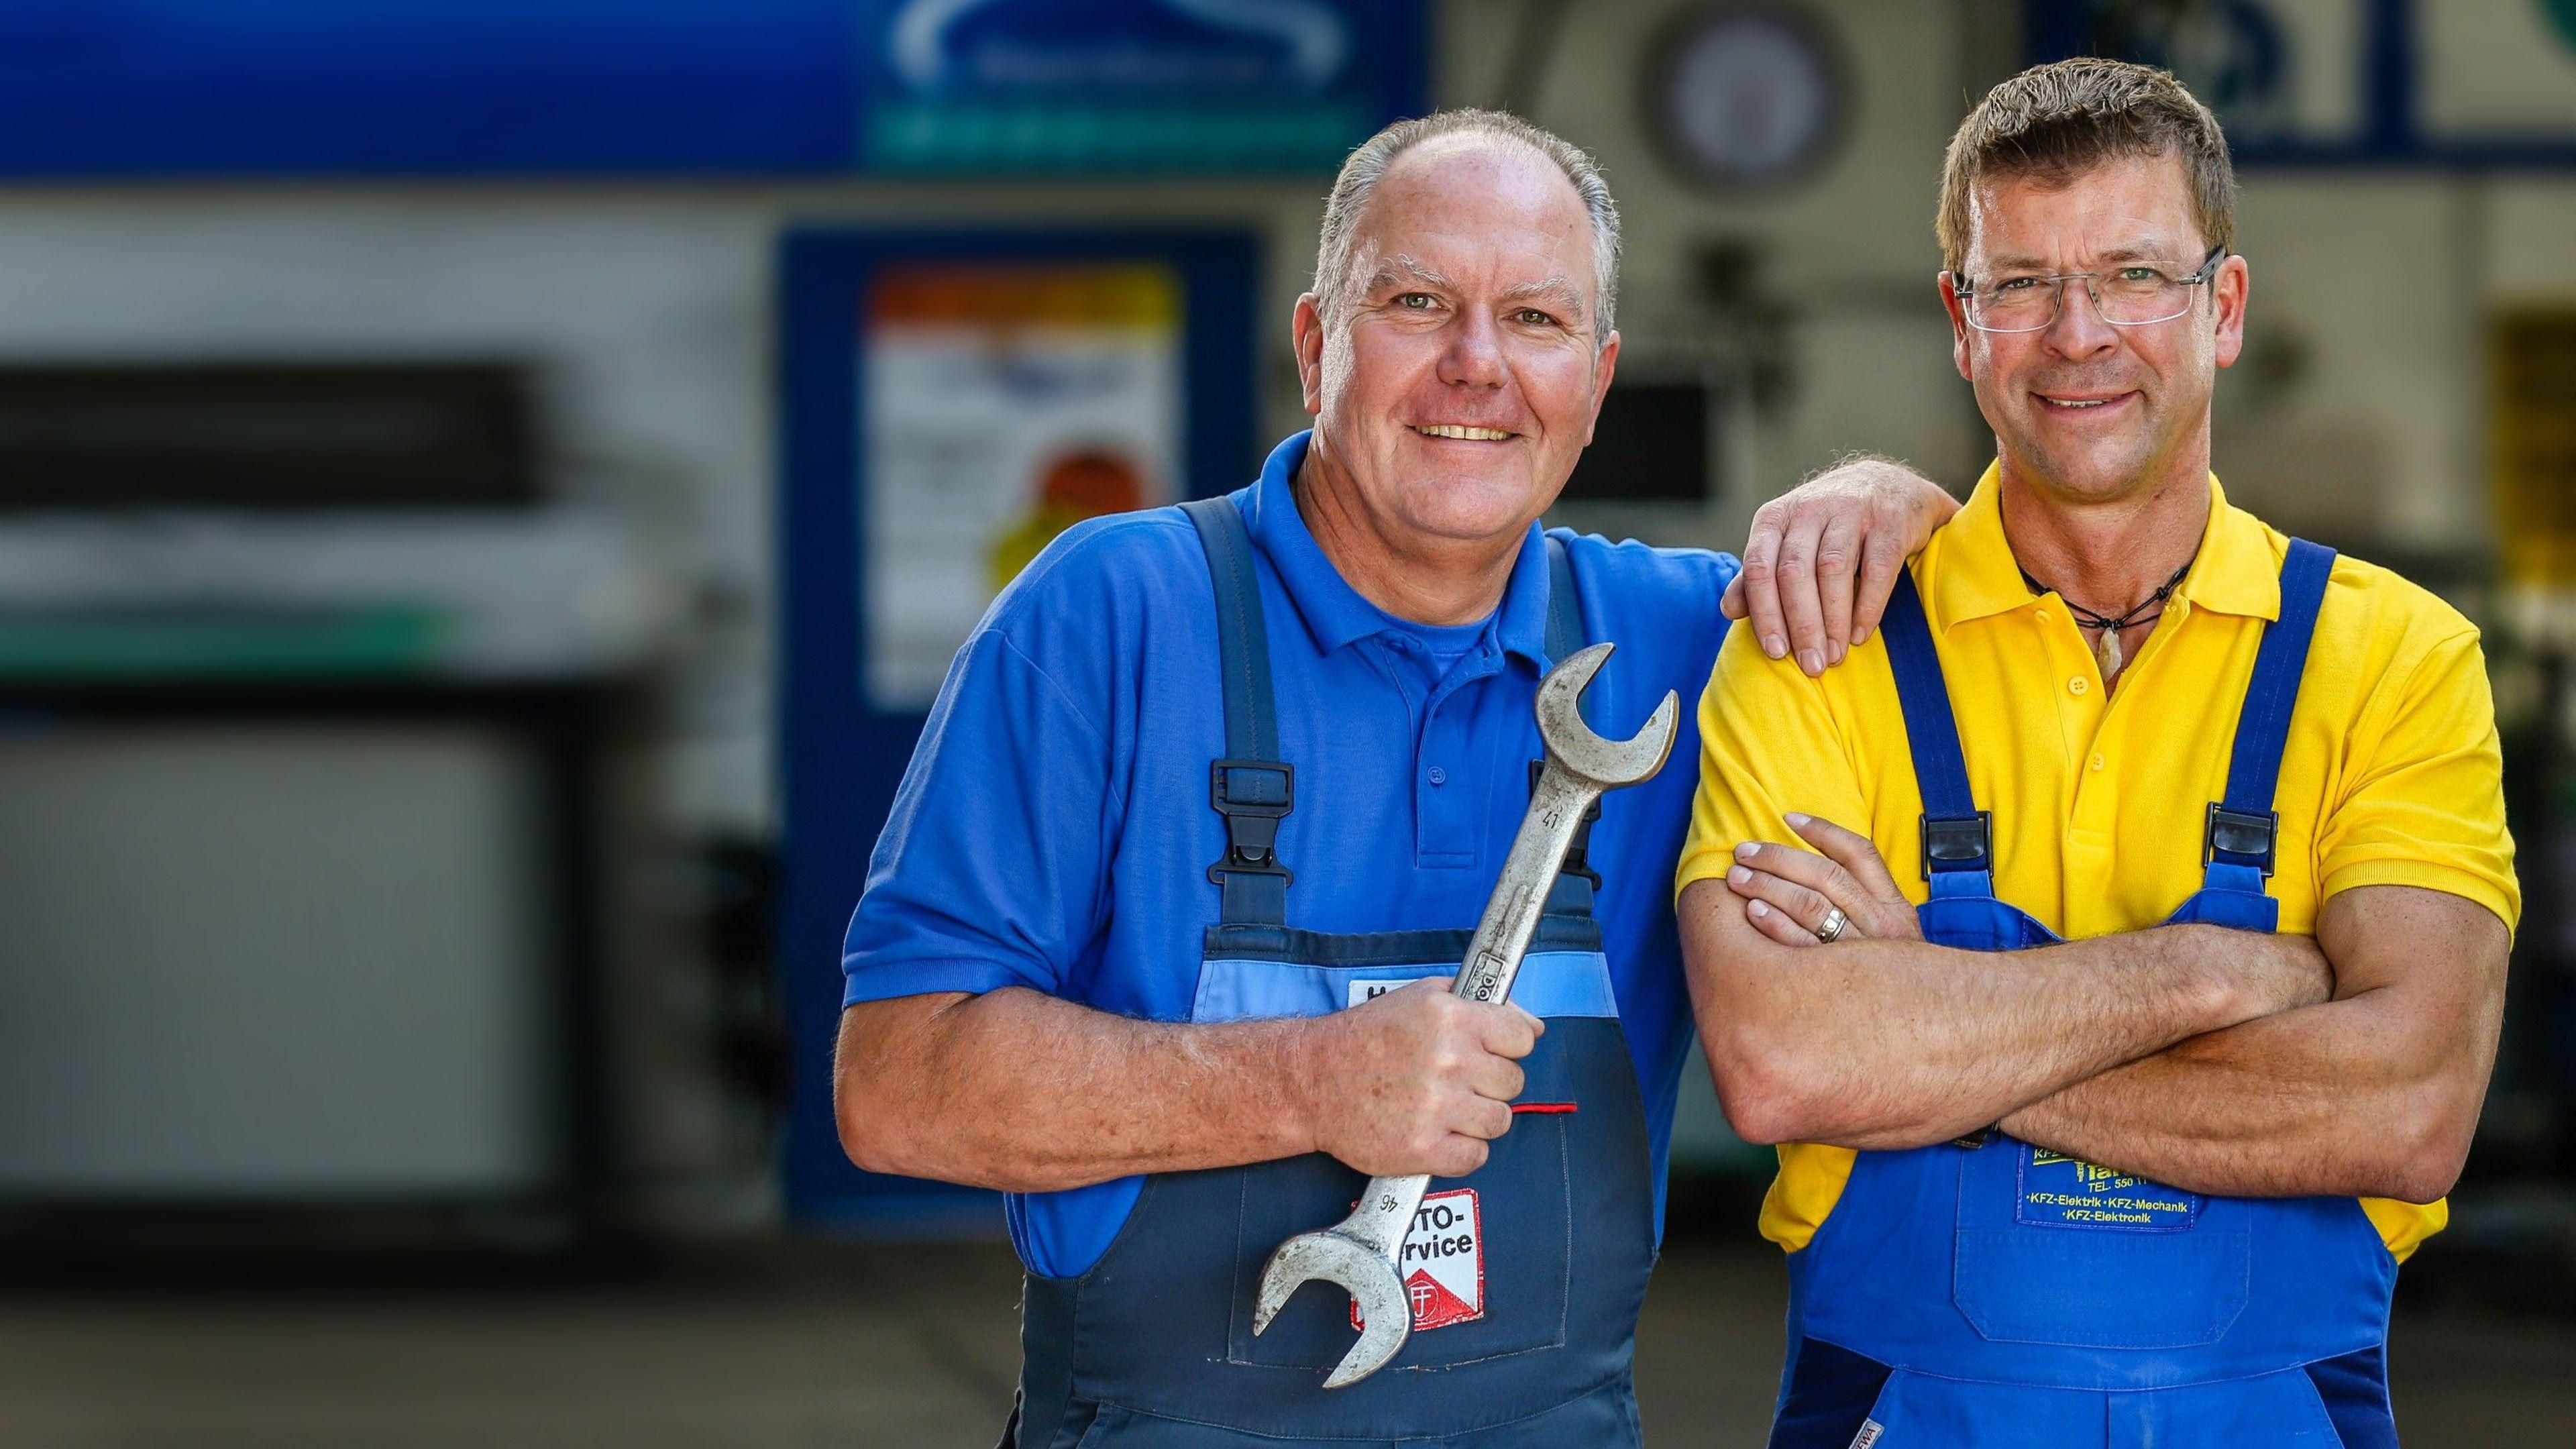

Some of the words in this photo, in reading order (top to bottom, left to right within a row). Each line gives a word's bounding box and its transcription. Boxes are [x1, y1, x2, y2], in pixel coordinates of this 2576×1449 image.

[2114, 1177, 2134, 1189] 550
[1409, 1205, 1464, 1232] TO-
[1402, 1234, 1472, 1260] rvice
